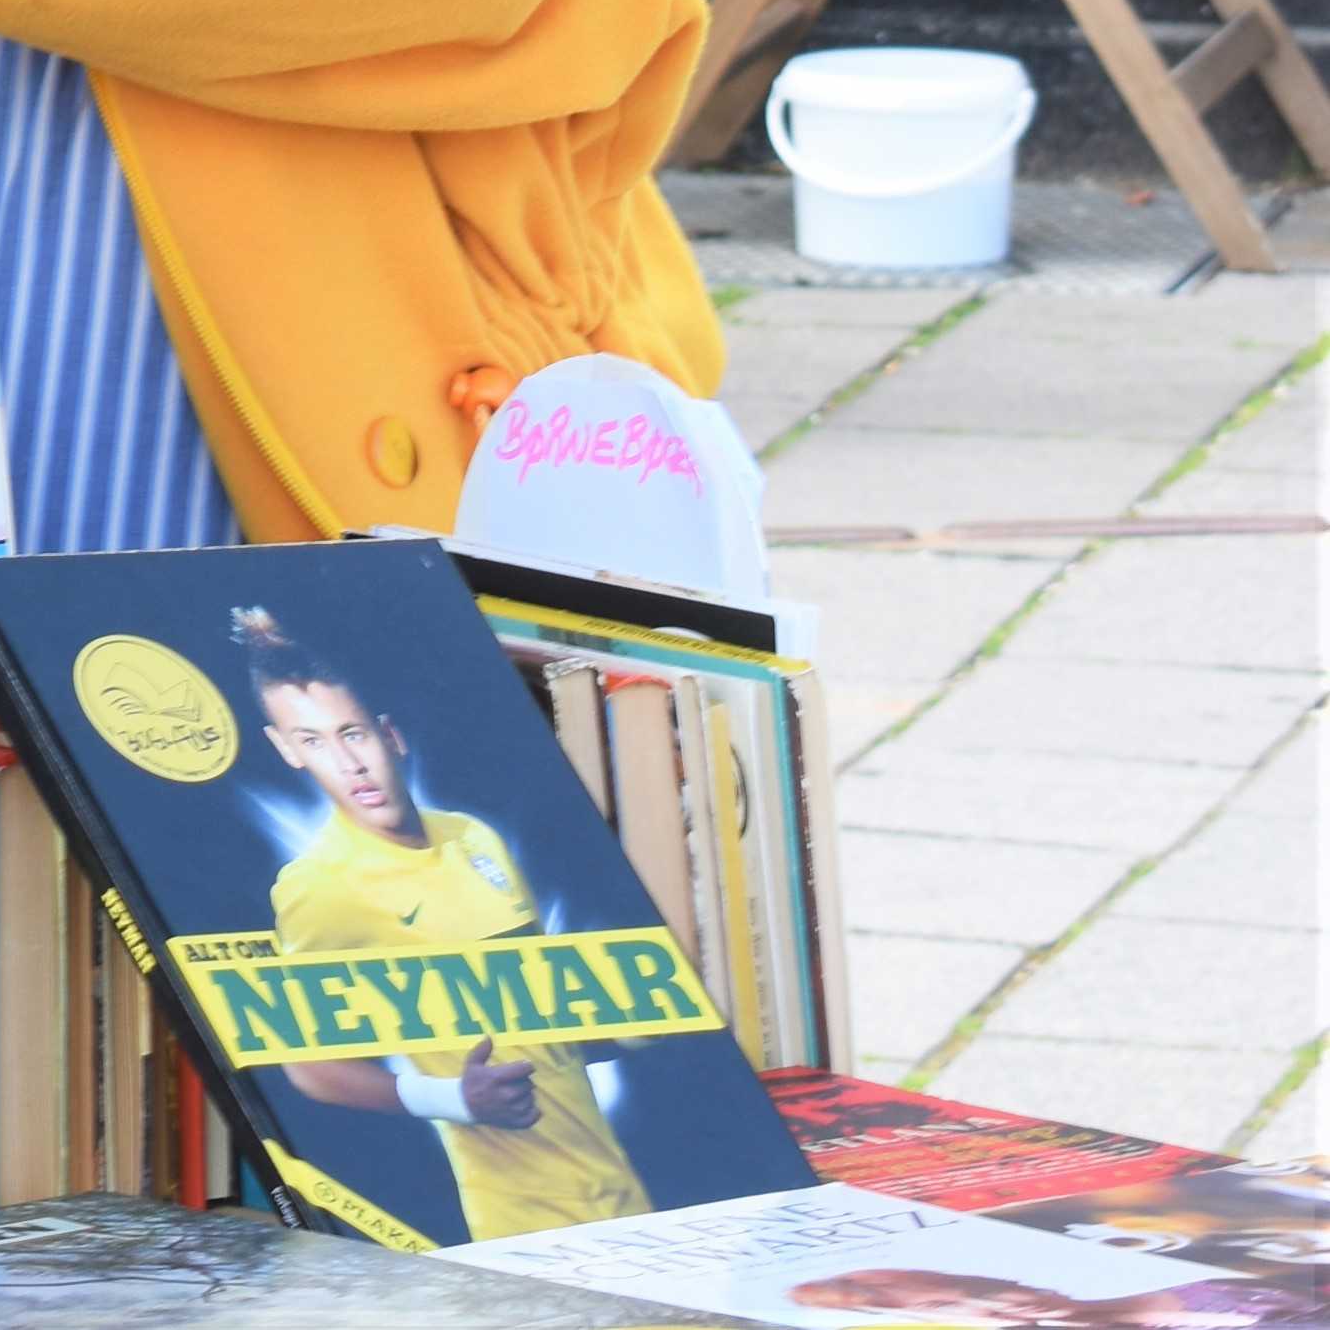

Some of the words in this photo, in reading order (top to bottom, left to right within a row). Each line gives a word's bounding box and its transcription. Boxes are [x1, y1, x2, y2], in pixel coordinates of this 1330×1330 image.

[99, 887, 161, 976] NEYMAR
[182, 940, 231, 965] ALT
[234, 937, 281, 962] OM
[209, 938, 703, 1056] NEYMAR
[505, 1201, 853, 1266] MALENE
